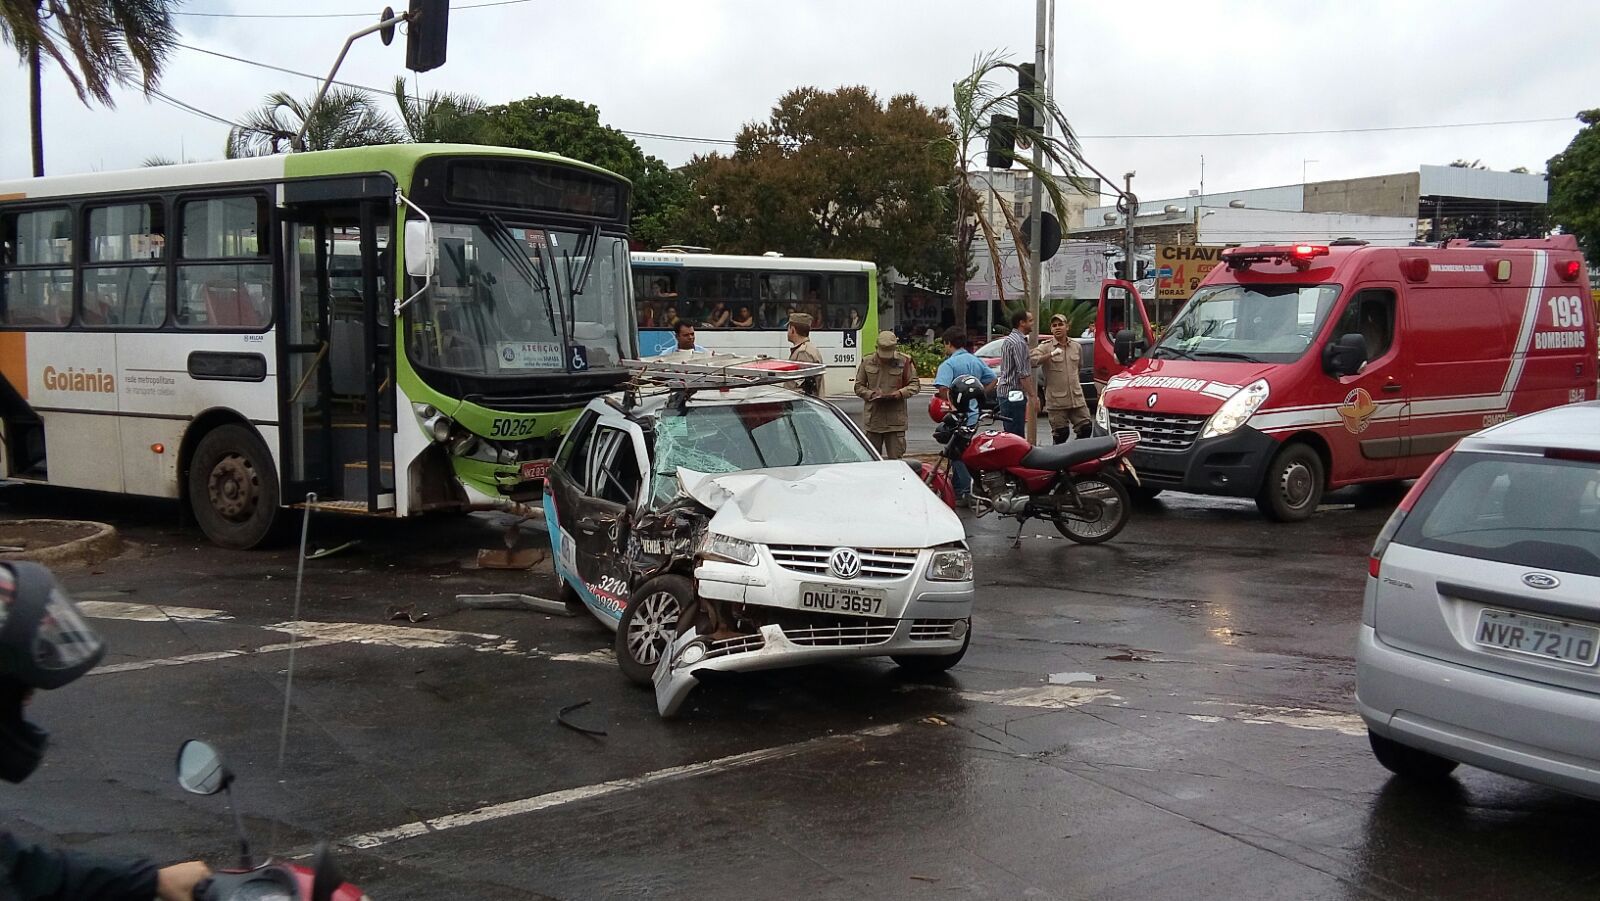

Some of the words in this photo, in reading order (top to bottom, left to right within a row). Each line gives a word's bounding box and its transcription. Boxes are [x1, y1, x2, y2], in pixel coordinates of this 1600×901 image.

[1548, 296, 1584, 327] 193
[521, 343, 559, 353] ATENÇÃO
[1535, 331, 1585, 349] BOMBEIROS
[834, 354, 855, 363] 50195
[43, 365, 115, 393] Goiânia
[490, 418, 537, 436] 50262
[1530, 574, 1550, 585] Ford
